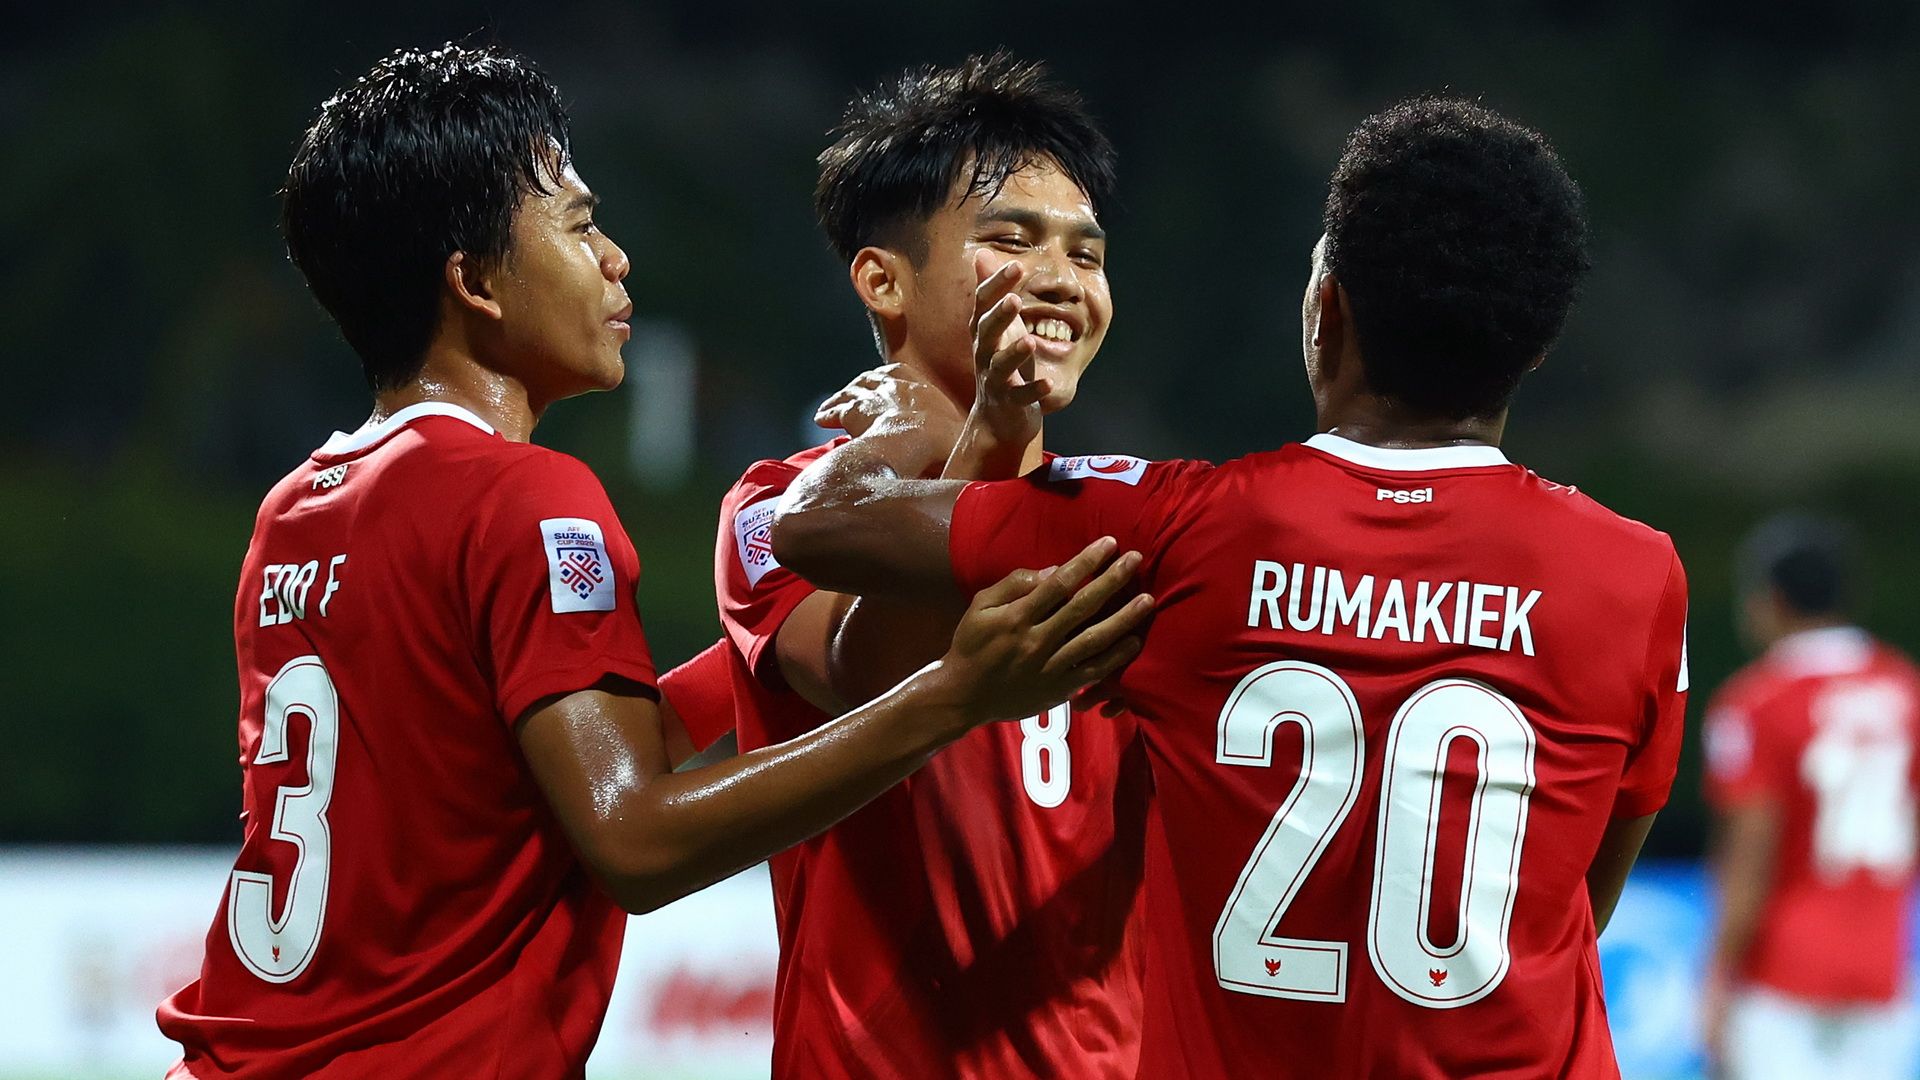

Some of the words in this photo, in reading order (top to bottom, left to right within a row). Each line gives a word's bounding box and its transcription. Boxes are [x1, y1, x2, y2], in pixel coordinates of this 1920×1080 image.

[312, 464, 348, 490] PSSI
[1376, 487, 1433, 504] PSSI
[554, 532, 595, 541] SUZUKI
[742, 509, 775, 528] SUZUK
[260, 559, 319, 628] EDO
[319, 553, 347, 617] F
[1247, 559, 1543, 657] RUMAKIEK
[1019, 700, 1071, 808] 8
[228, 655, 339, 983] 3
[1212, 660, 1537, 1009] 20
